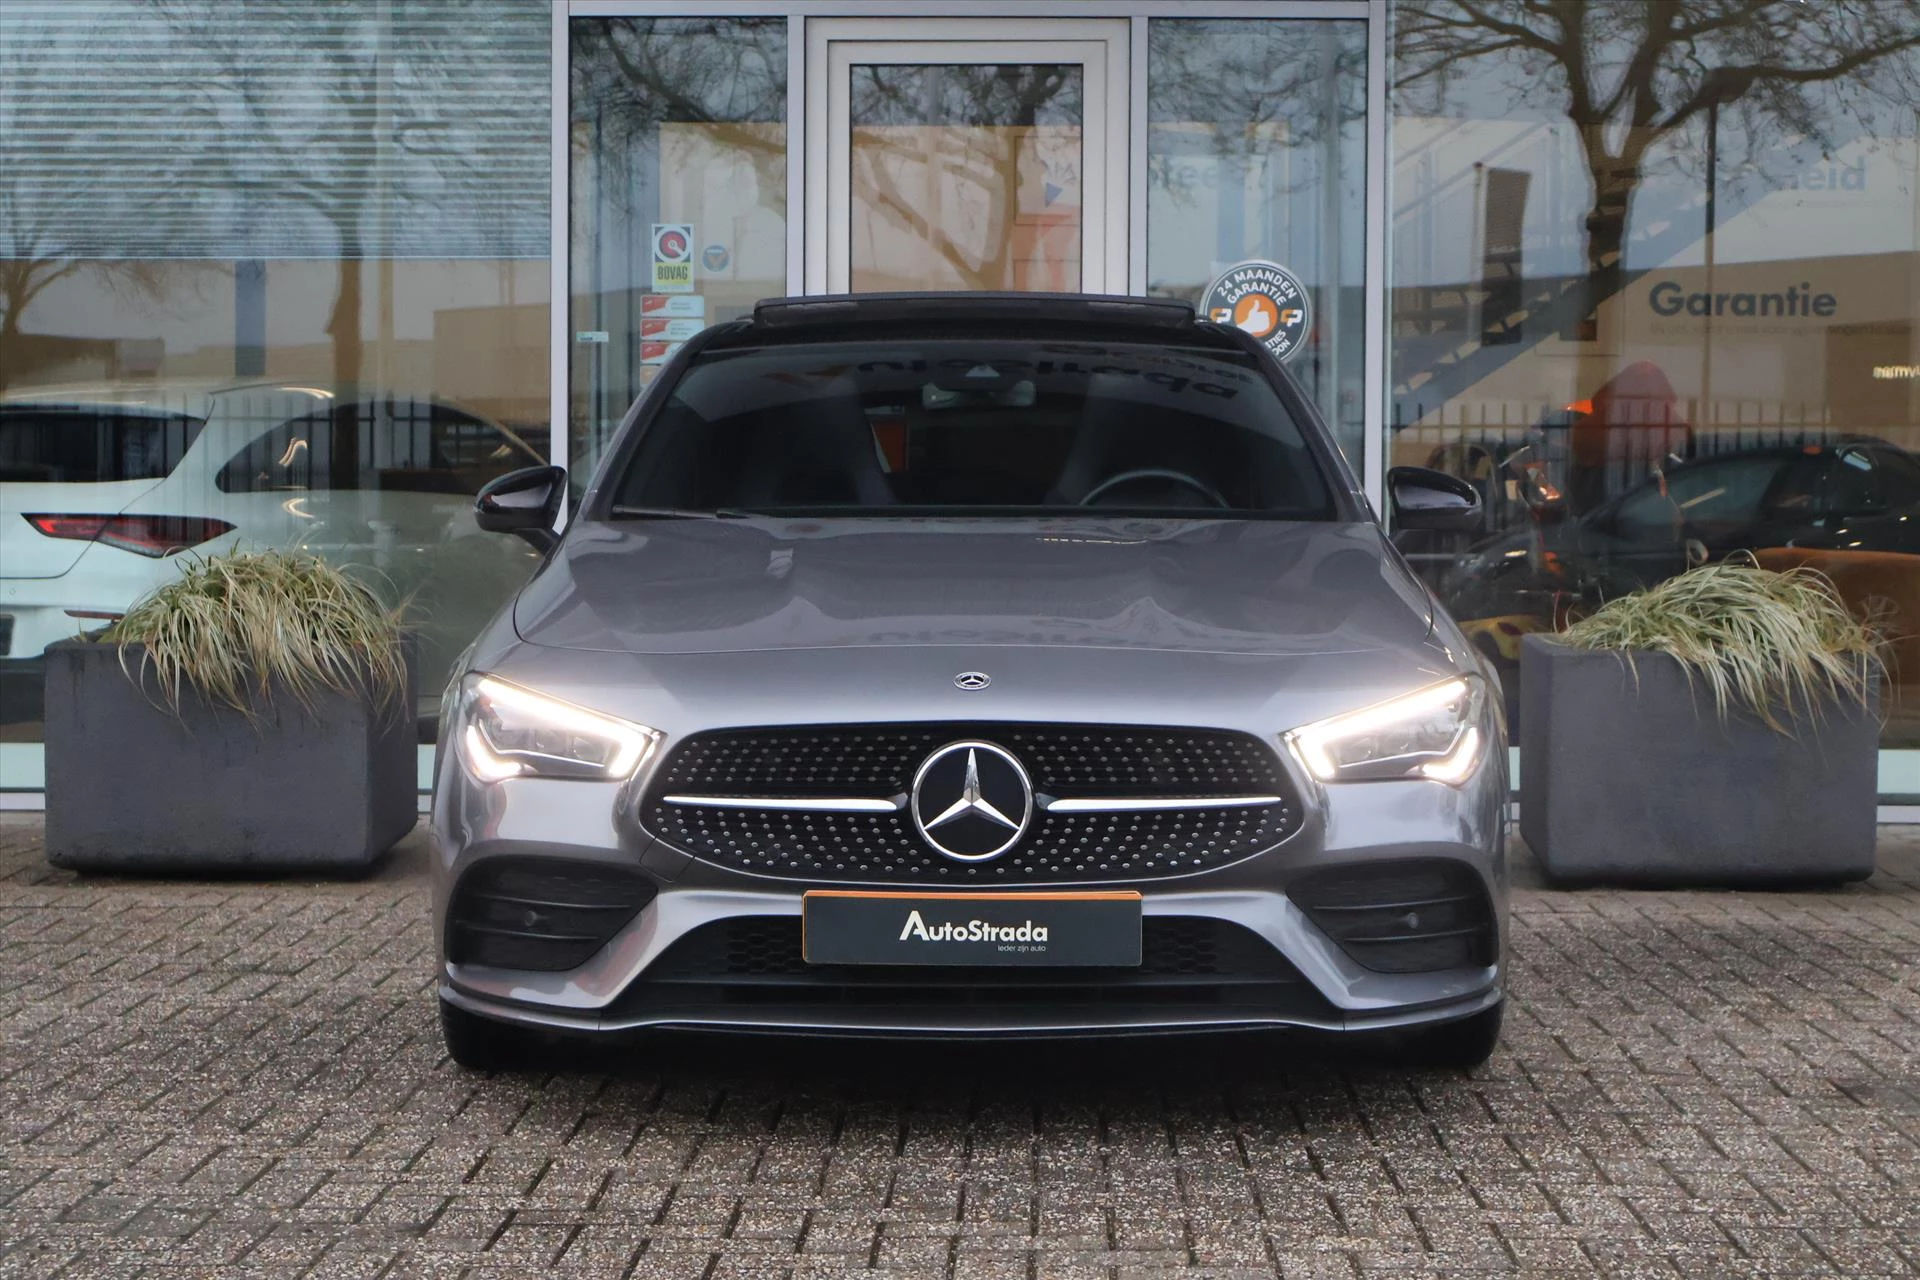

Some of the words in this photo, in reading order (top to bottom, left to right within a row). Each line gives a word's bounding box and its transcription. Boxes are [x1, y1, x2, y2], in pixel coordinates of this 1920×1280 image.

[657, 265, 688, 280] BOVAG
[1217, 280, 1233, 297] 24
[1234, 269, 1297, 299] MAANDEN
[1227, 282, 1287, 306] GARANTIE
[1649, 281, 1838, 317] Garantie
[898, 909, 1048, 942] AutoStrada
[1030, 944, 1047, 952] auto
